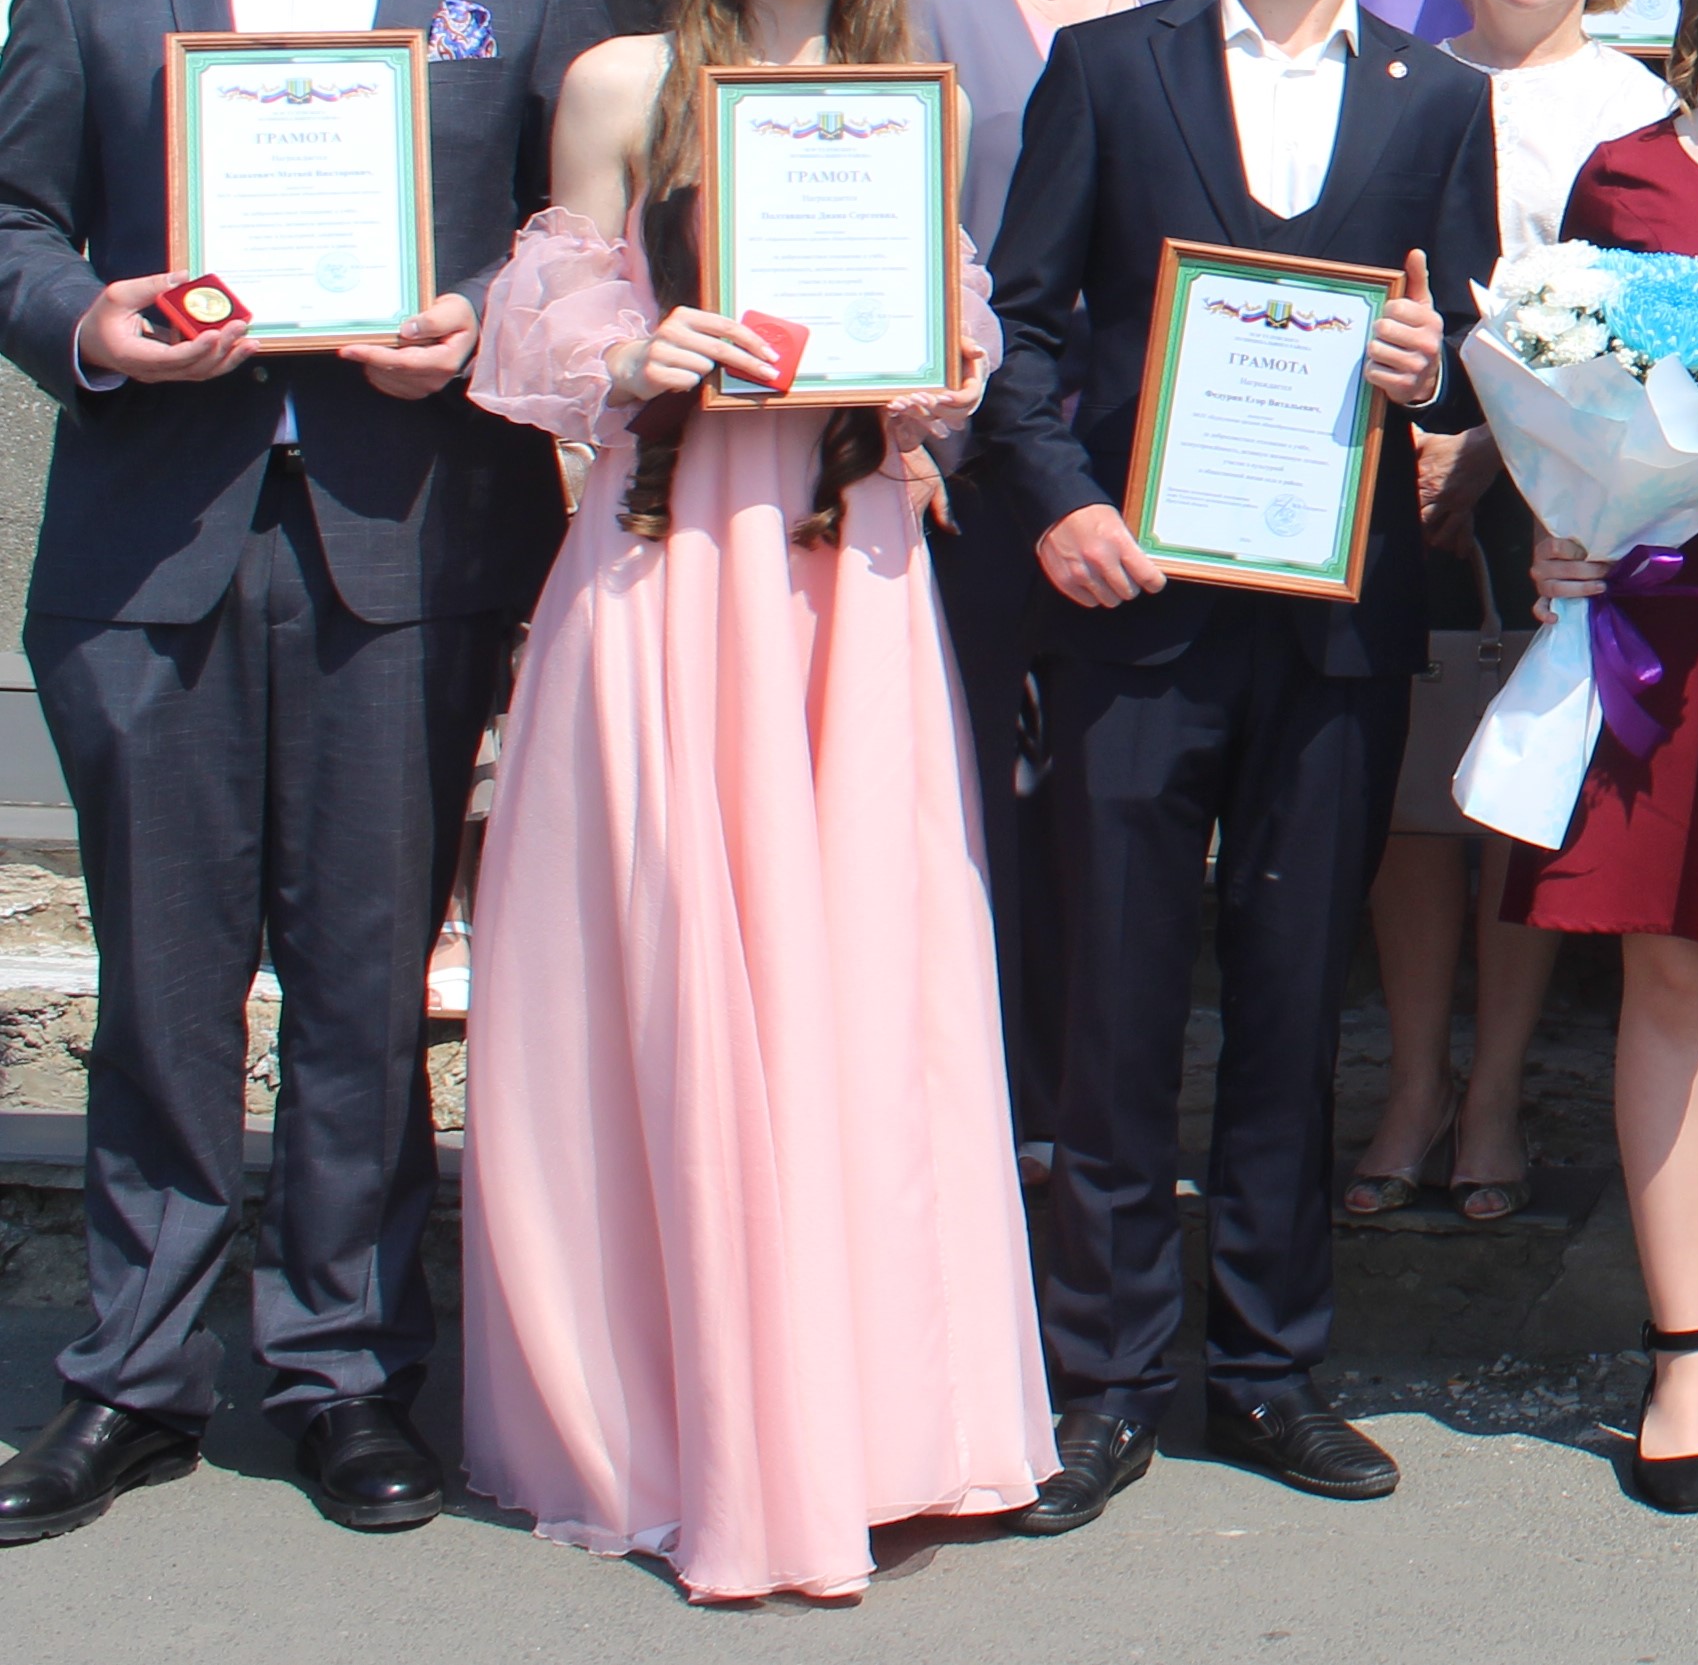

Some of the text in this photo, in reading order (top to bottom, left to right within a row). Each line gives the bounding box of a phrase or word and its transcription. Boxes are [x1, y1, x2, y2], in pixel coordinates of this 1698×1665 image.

[255, 132, 342, 144] ГРАМОТА
[786, 171, 872, 183] ГРАМОТА
[1229, 352, 1309, 375] ГРАМОТА
